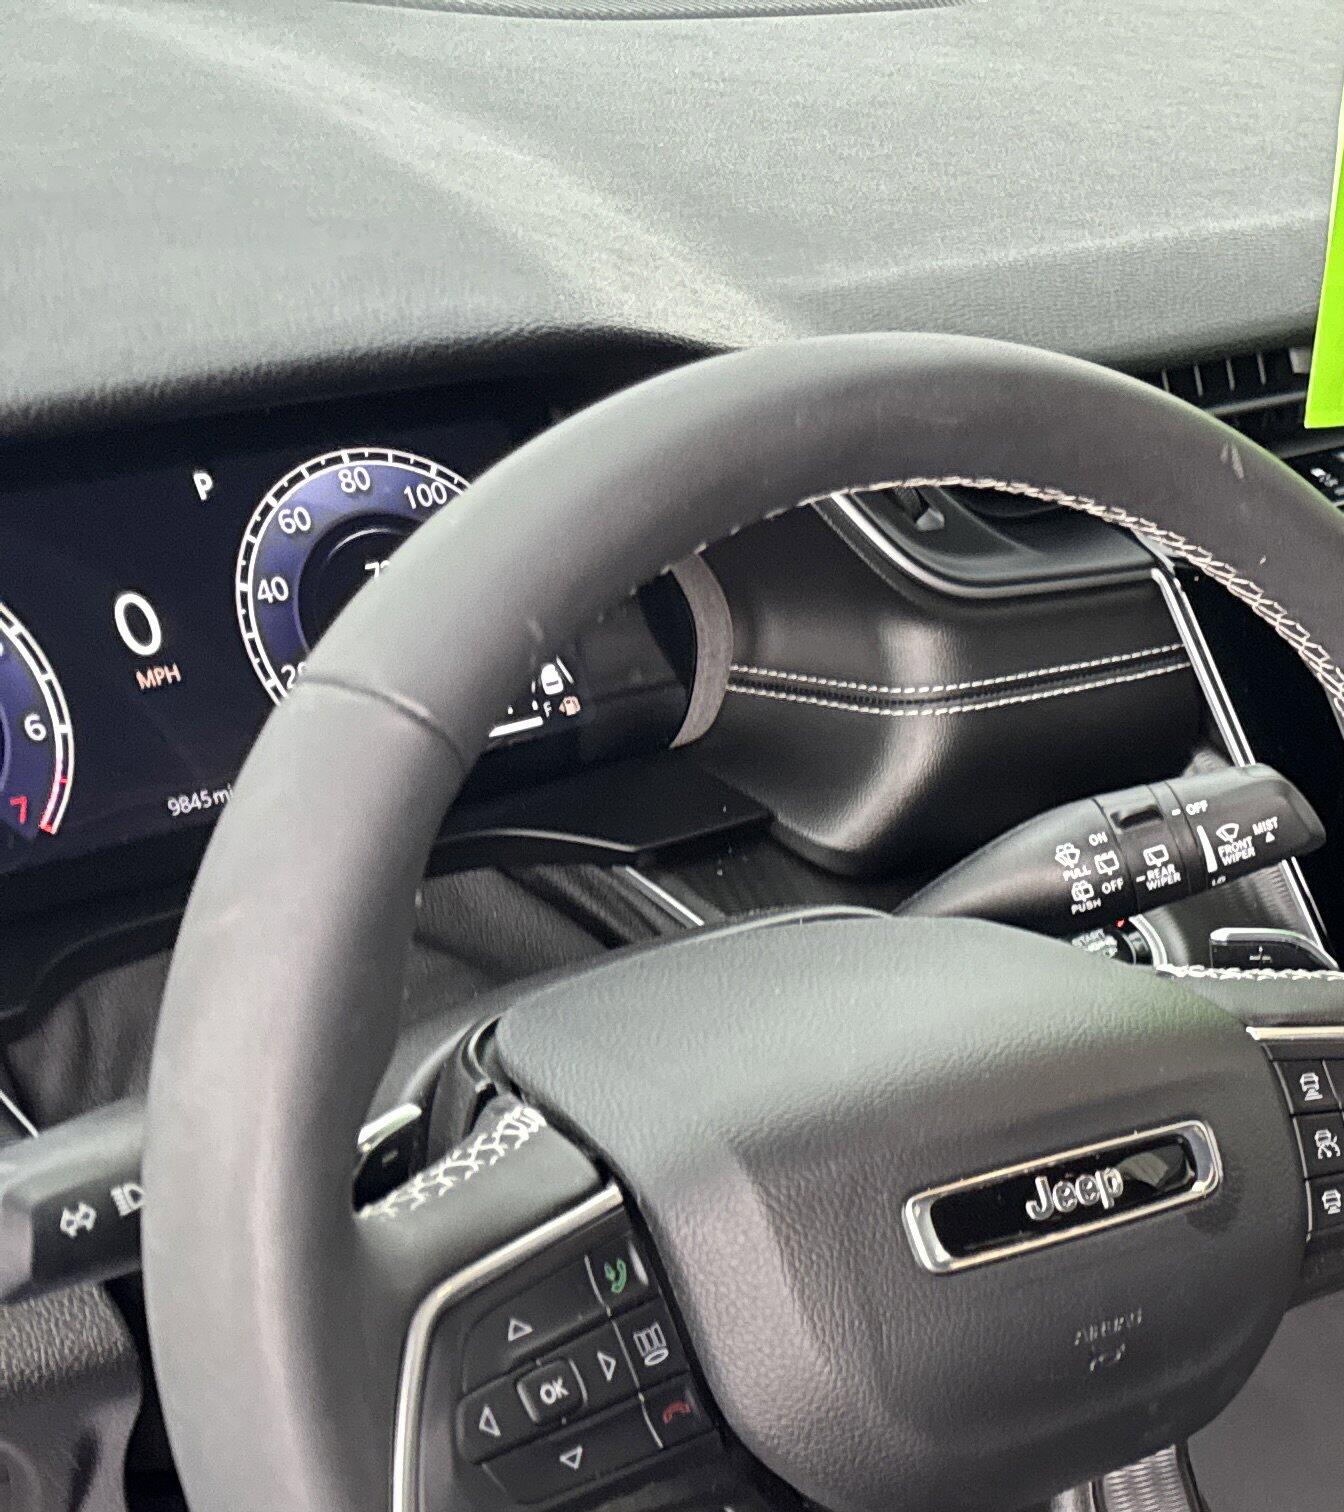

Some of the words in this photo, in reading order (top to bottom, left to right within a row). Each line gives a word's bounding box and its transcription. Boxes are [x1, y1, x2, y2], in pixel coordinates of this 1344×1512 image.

[192, 470, 215, 502] P
[337, 466, 371, 493] 80
[403, 481, 448, 510] 100
[278, 506, 312, 535] 60
[257, 576, 290, 604] 40
[114, 590, 162, 657] 0
[135, 663, 182, 692] MPH
[24, 712, 47, 742] 6
[10, 795, 27, 824] 7
[1186, 800, 1208, 816] OFF
[1088, 831, 1108, 846] ON
[1252, 816, 1279, 836] MIST
[1217, 835, 1253, 856] FRONT
[1221, 847, 1256, 867] WIPER
[1063, 865, 1092, 882] PULL
[1146, 863, 1176, 882] REAR
[1146, 872, 1181, 892] WIPER
[1101, 878, 1124, 895] OFF
[1071, 898, 1102, 916] PUSH
[1025, 1167, 1124, 1220] Jeep
[538, 1375, 568, 1405] OK
